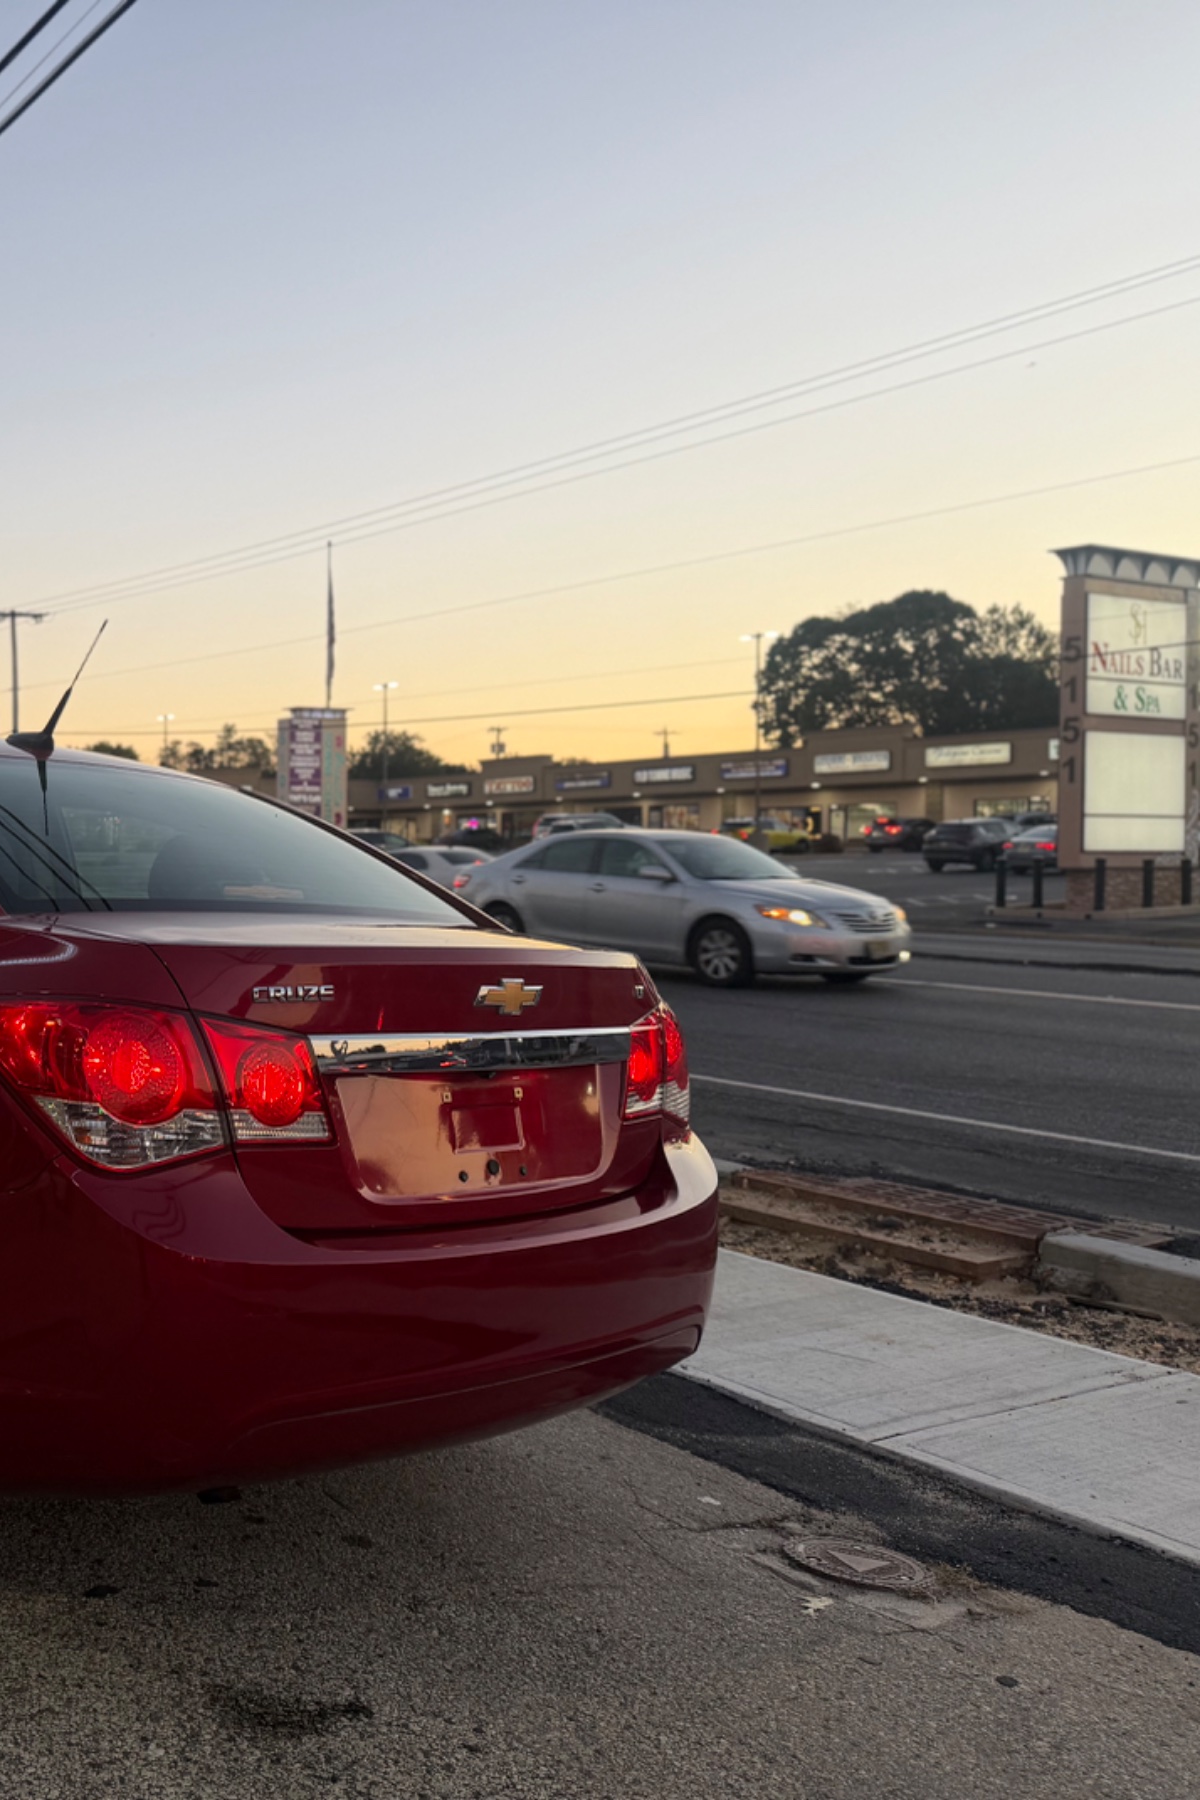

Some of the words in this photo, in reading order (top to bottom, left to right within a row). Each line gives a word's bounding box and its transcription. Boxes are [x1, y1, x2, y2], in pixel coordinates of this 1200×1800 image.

[1091, 641, 1144, 676] NAILS
[1149, 647, 1183, 680] BAR
[1114, 684, 1128, 712] &
[1134, 686, 1161, 714] SPA
[253, 984, 334, 1003] CRUZE
